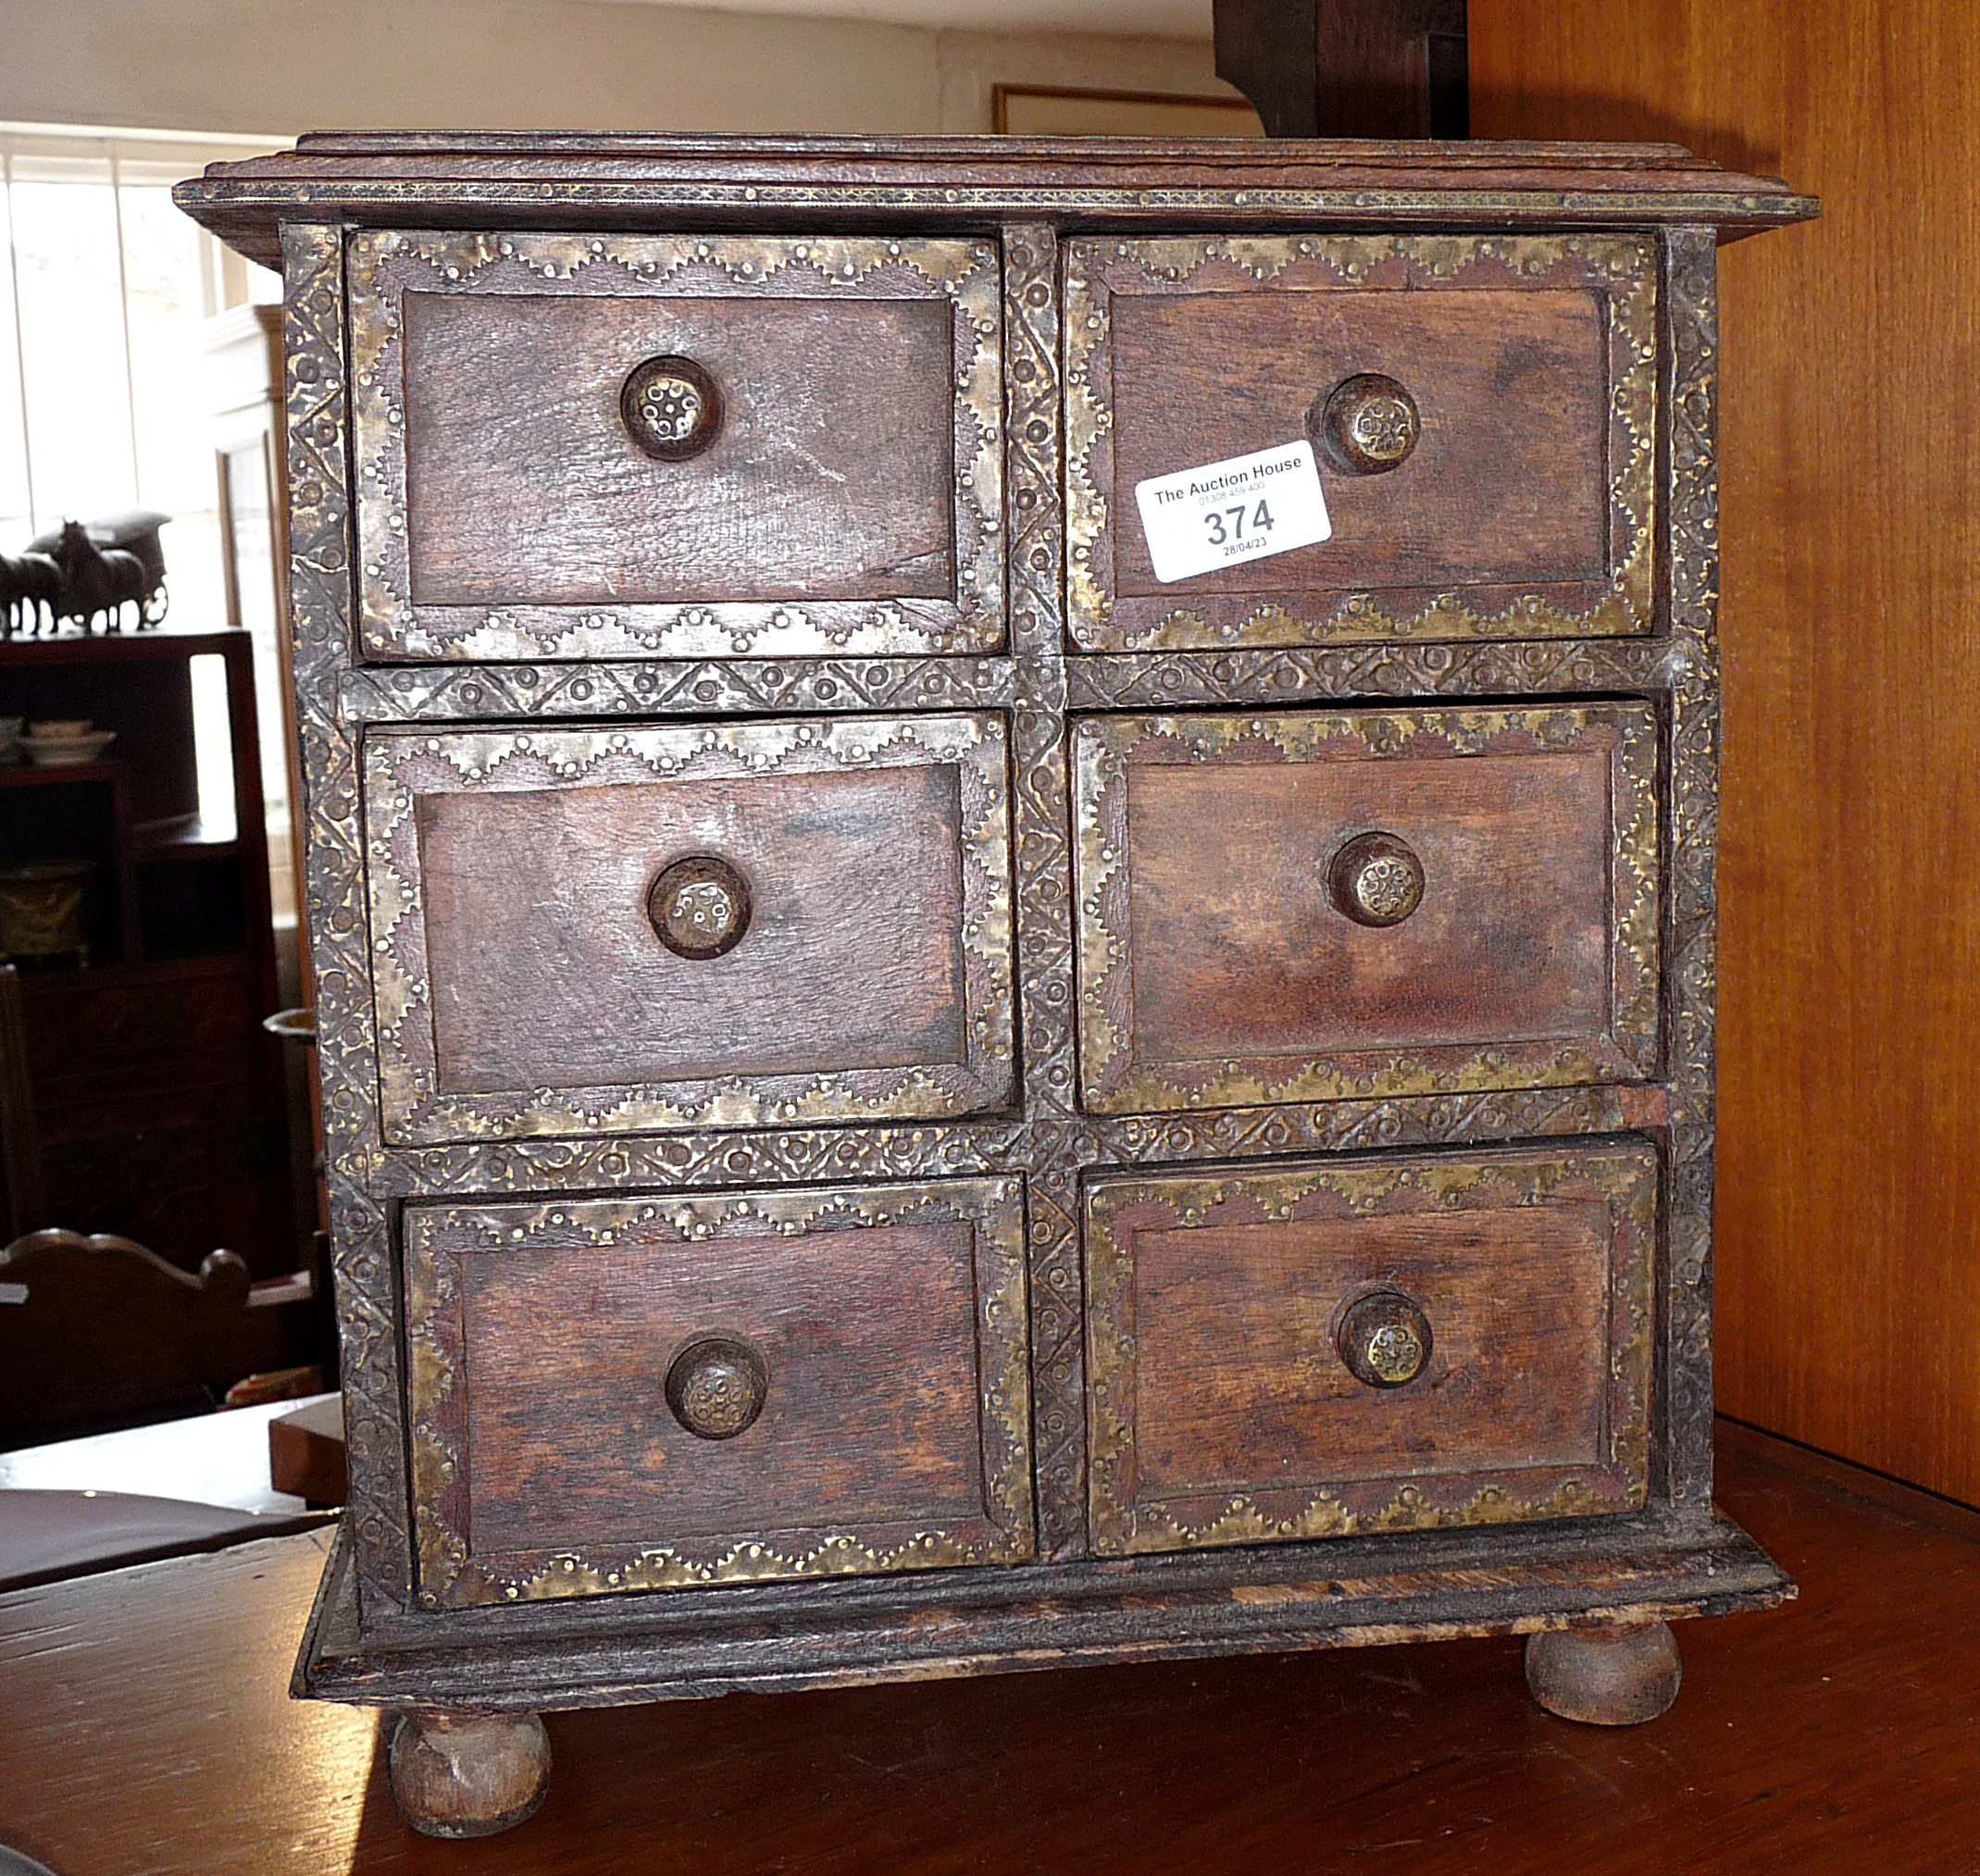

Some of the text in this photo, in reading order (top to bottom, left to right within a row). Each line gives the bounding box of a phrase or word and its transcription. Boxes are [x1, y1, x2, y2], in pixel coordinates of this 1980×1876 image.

[1154, 458, 1301, 504] The Auction House
[1199, 492, 1227, 505] 01308
[1248, 481, 1264, 491] 400
[1204, 499, 1275, 545] 374
[1224, 537, 1267, 556] 28/04/23
